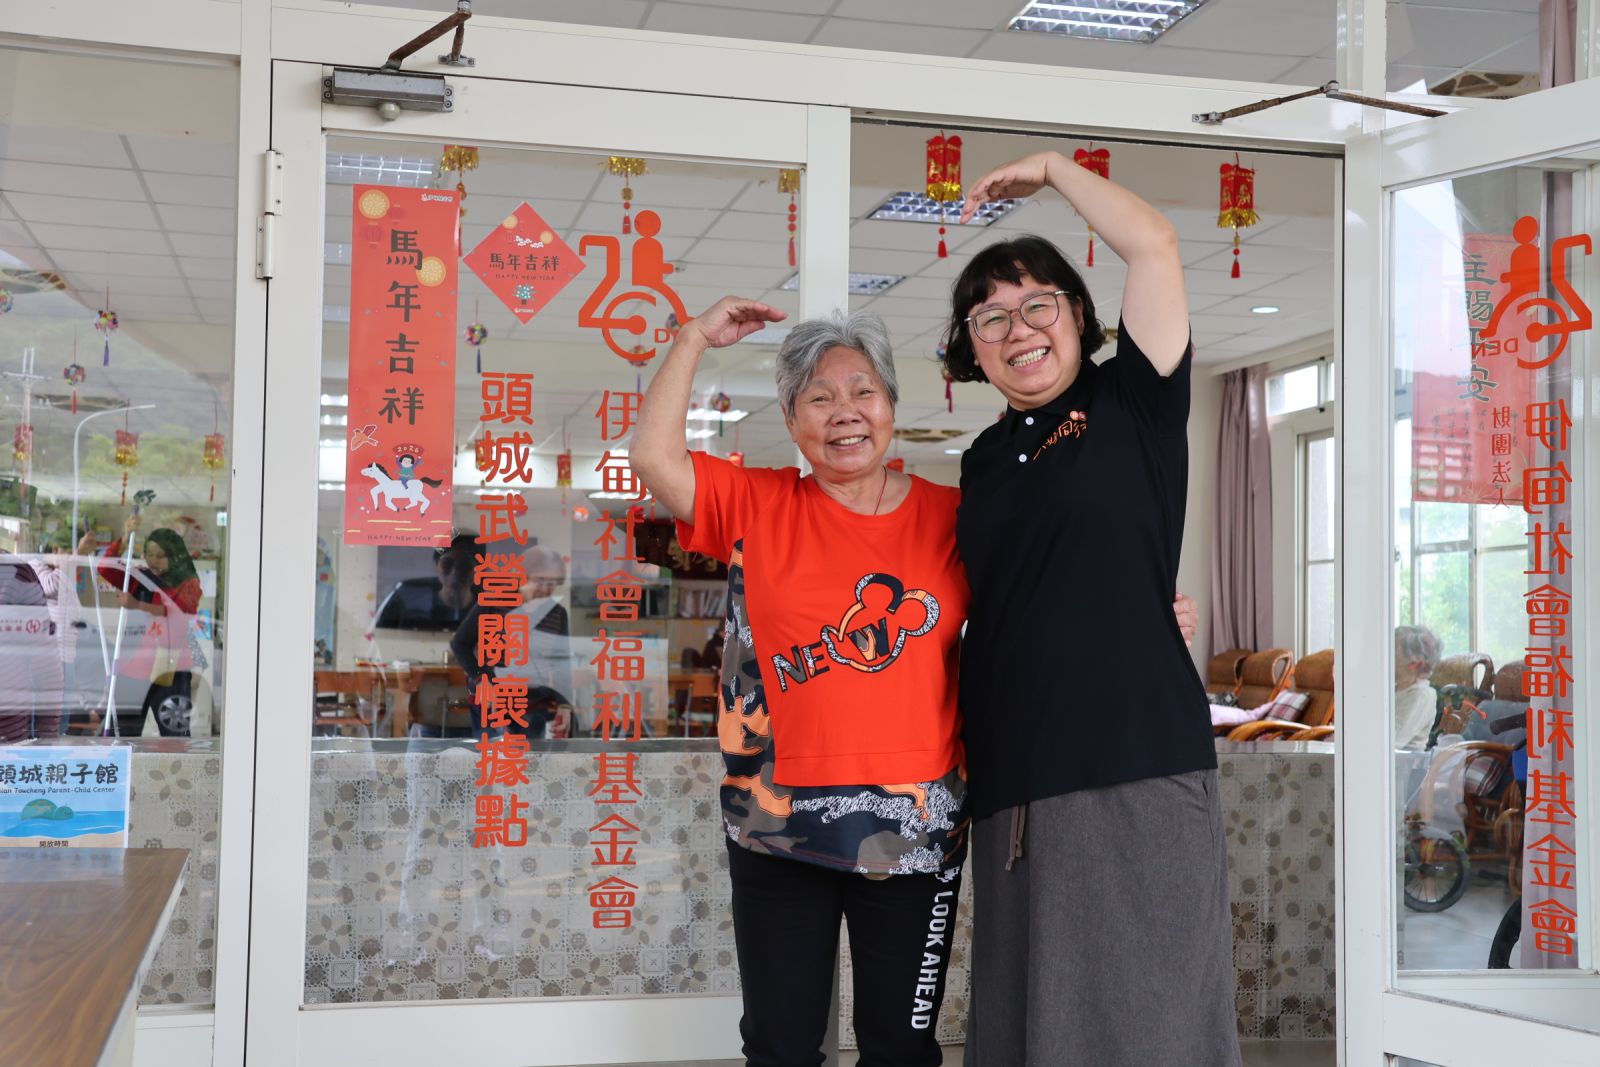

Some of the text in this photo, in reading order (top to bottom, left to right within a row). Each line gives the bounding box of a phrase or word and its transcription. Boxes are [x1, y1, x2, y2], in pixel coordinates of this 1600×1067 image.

[378, 228, 425, 426] 馬年吉祥
[489, 252, 560, 272] 馬年吉祥
[397, 445, 420, 454] 2026
[473, 371, 535, 849] 頭城武營關懷據點
[586, 389, 648, 929] 伊甸社會福利基金會
[771, 617, 890, 692] NEW
[911, 890, 954, 1030] LOOK AHEAD
